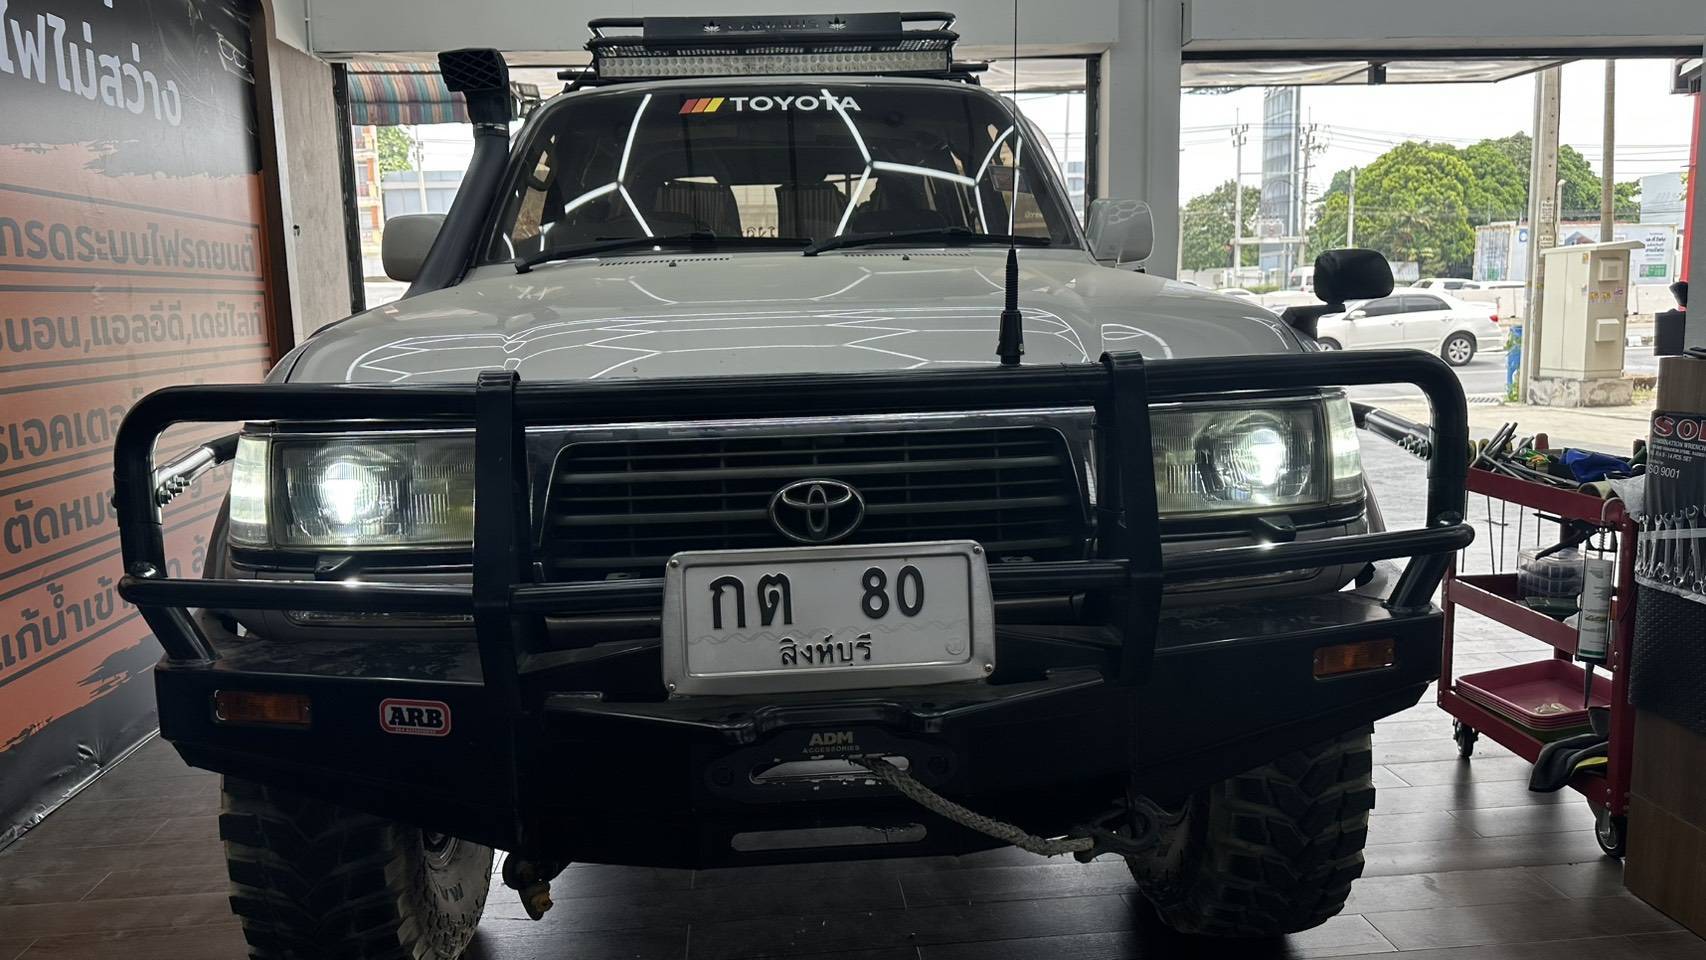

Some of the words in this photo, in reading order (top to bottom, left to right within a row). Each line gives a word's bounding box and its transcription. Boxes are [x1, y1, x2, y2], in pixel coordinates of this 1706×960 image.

[729, 96, 861, 111] TOYOTA
[1660, 466, 1680, 479] 9001
[710, 573, 792, 629] กต
[862, 565, 924, 619] 80
[779, 632, 871, 666] สิงห์บุรี
[389, 706, 444, 728] ARB
[809, 731, 853, 746] ADM
